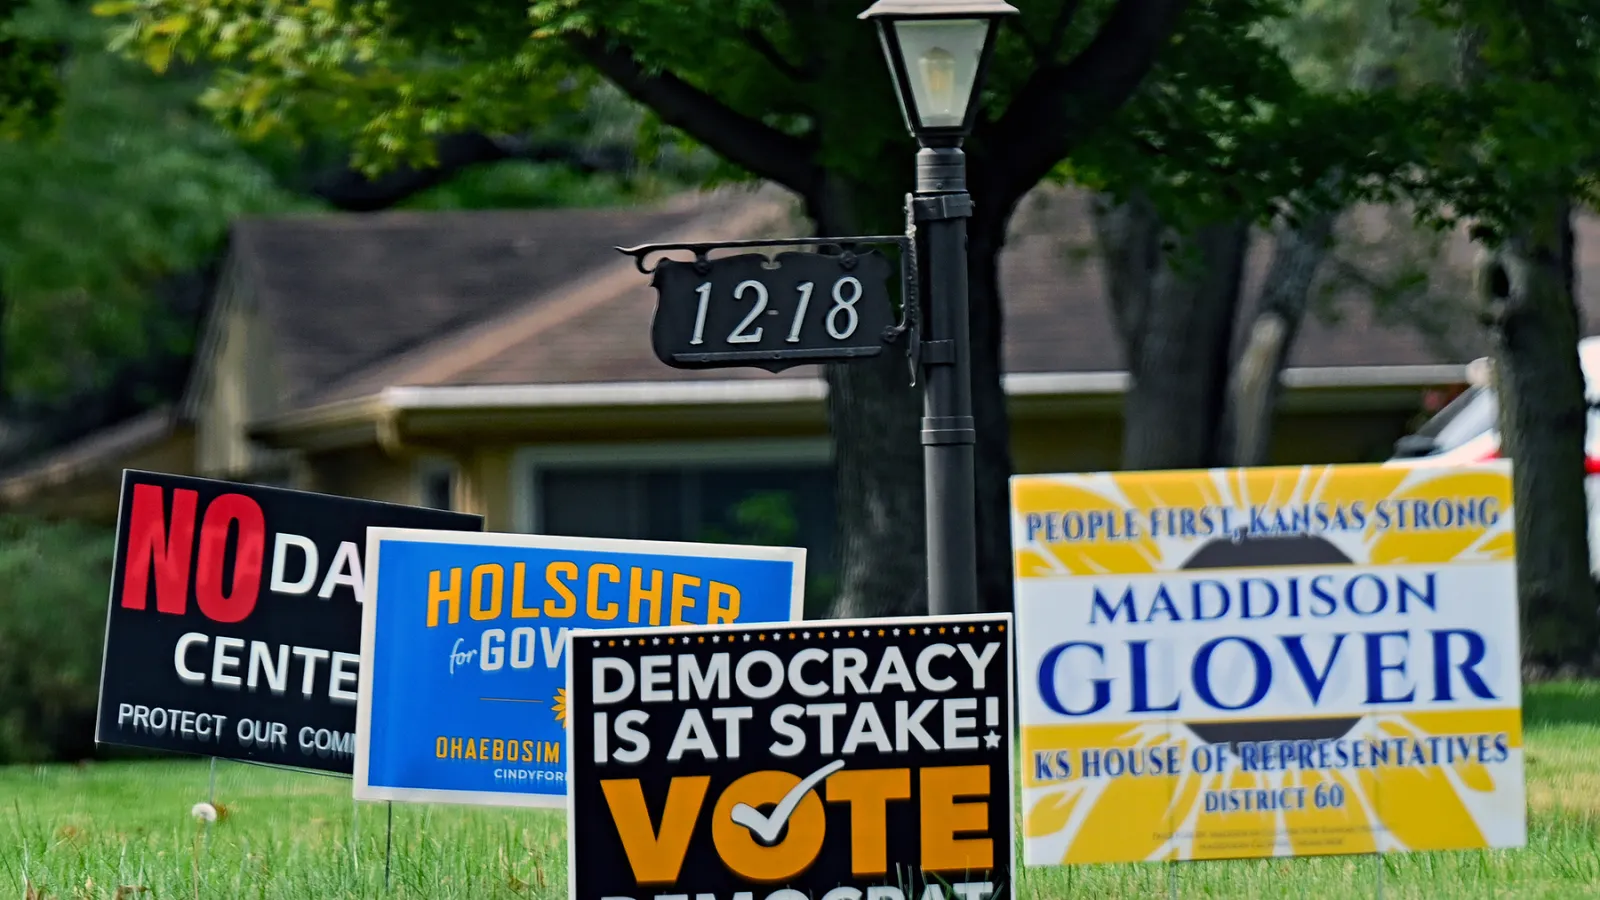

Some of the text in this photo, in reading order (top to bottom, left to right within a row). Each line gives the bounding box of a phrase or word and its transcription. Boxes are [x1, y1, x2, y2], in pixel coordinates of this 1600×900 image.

[1025, 512, 1139, 542] PEOPLE
[1249, 500, 1366, 533] KANSAS
[1375, 496, 1499, 530] STRONG
[121, 483, 365, 623] NO DA
[425, 560, 742, 628] HOLSCHER
[1087, 571, 1438, 624] MADDISON
[173, 632, 360, 701] CENTE
[449, 625, 569, 675] for GOV
[592, 642, 1000, 704] DEMOCRACY
[1036, 628, 1501, 717] GLOVER
[117, 703, 357, 755] PROTECT OUR COM
[436, 736, 560, 763] OHAEBOSIM
[593, 696, 1002, 763] IS AT STAKE!
[494, 768, 568, 782] CINDYFOR
[1034, 733, 1509, 780] KS HOUSE OF REPRESENTATIVES
[599, 764, 994, 884] VOTE
[1204, 783, 1344, 813] DISTRICT 60
